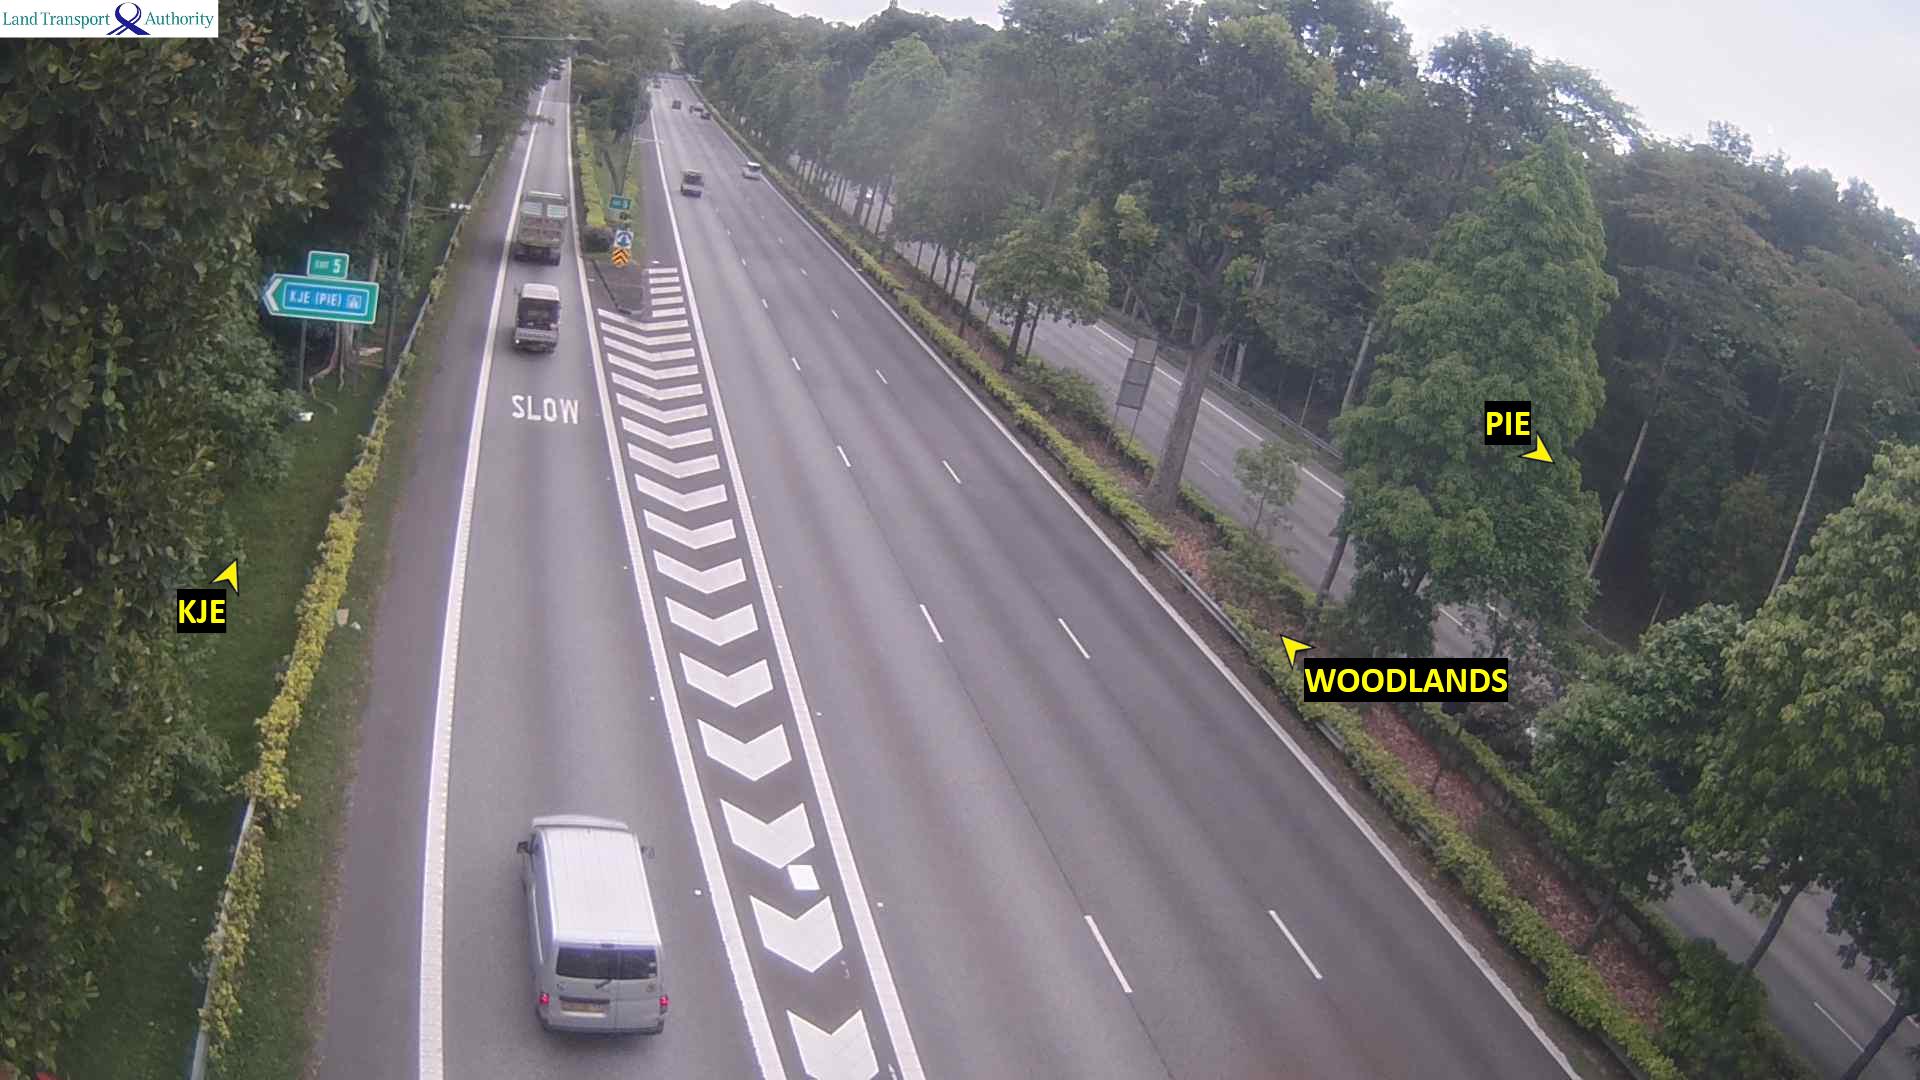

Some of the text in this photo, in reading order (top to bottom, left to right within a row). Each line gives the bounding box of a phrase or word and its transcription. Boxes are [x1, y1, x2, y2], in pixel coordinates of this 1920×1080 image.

[333, 259, 342, 273] 5
[289, 290, 342, 307] KJE (PIE)
[511, 395, 578, 424] SLOW
